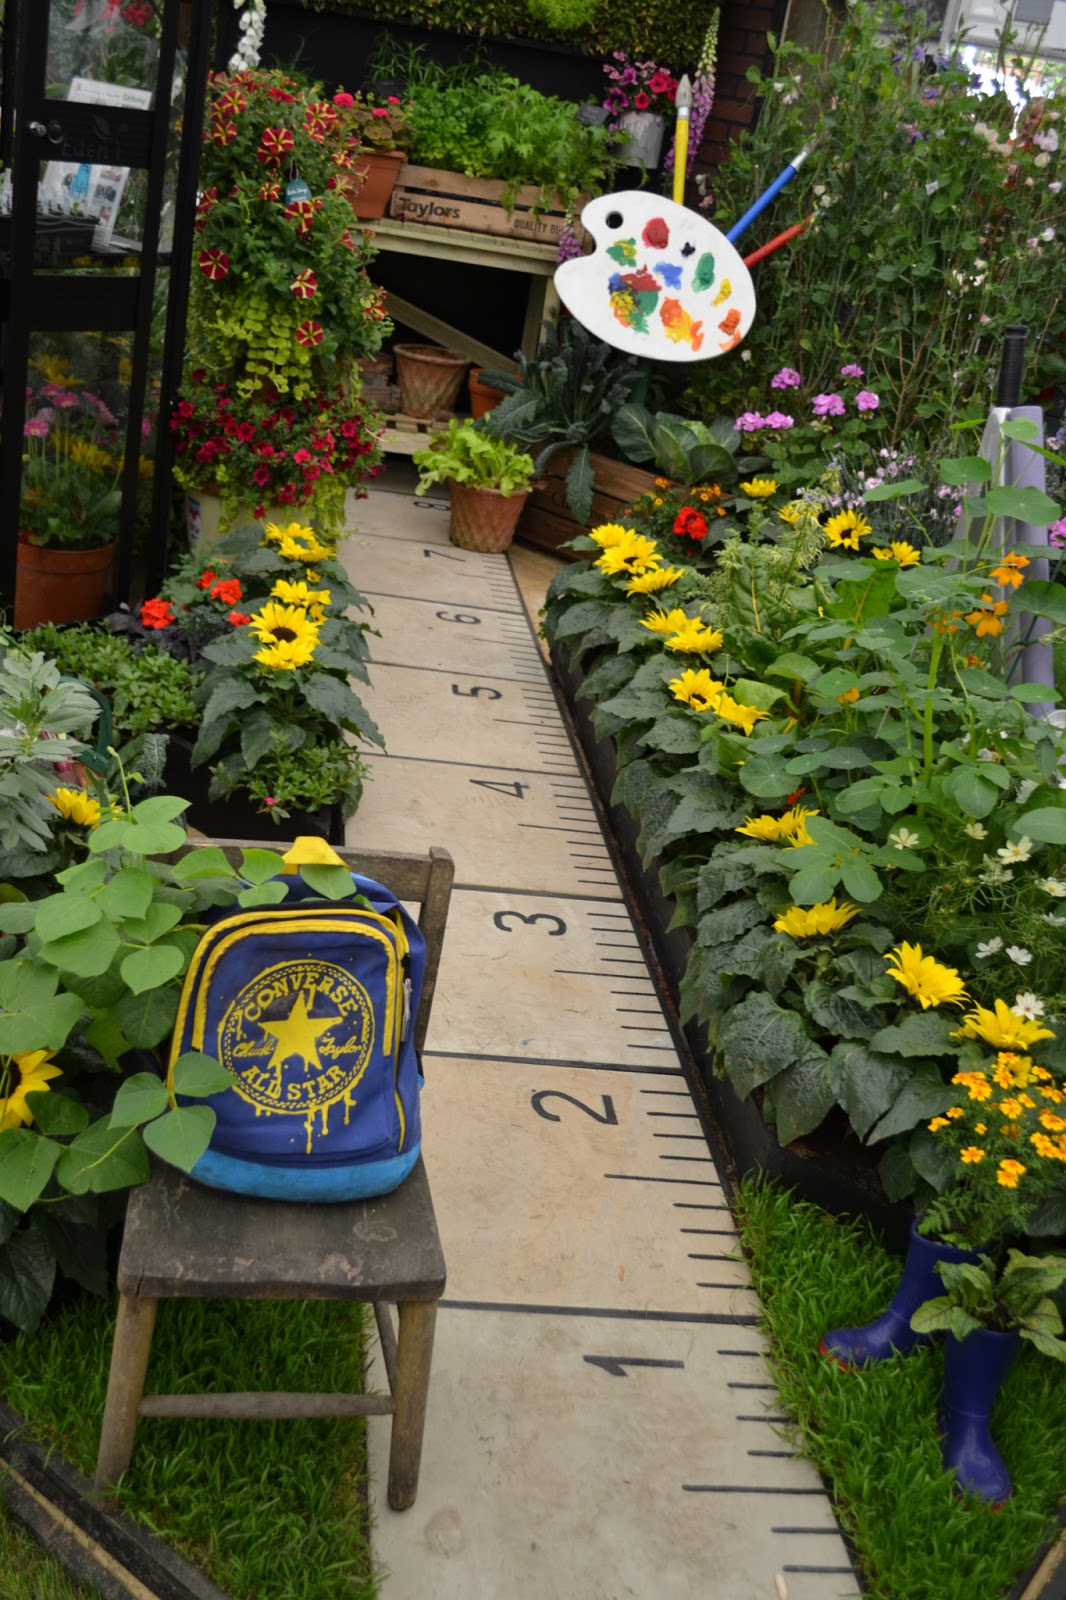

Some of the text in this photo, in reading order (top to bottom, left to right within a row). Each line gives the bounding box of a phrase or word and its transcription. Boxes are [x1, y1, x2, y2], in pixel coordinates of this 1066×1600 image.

[398, 197, 461, 219] Taylors
[513, 218, 548, 234] QUALITY
[413, 501, 451, 512] 8
[423, 549, 466, 563] 7
[435, 610, 482, 625] 6
[451, 683, 503, 700] 5
[468, 778, 530, 800] 4
[493, 910, 567, 936] 3
[244, 972, 358, 1021] CONVERSE
[318, 1036, 363, 1060] Taylor
[241, 1065, 347, 1101] ALL STAR
[530, 1089, 619, 1126] 2
[583, 1354, 685, 1377] 1
